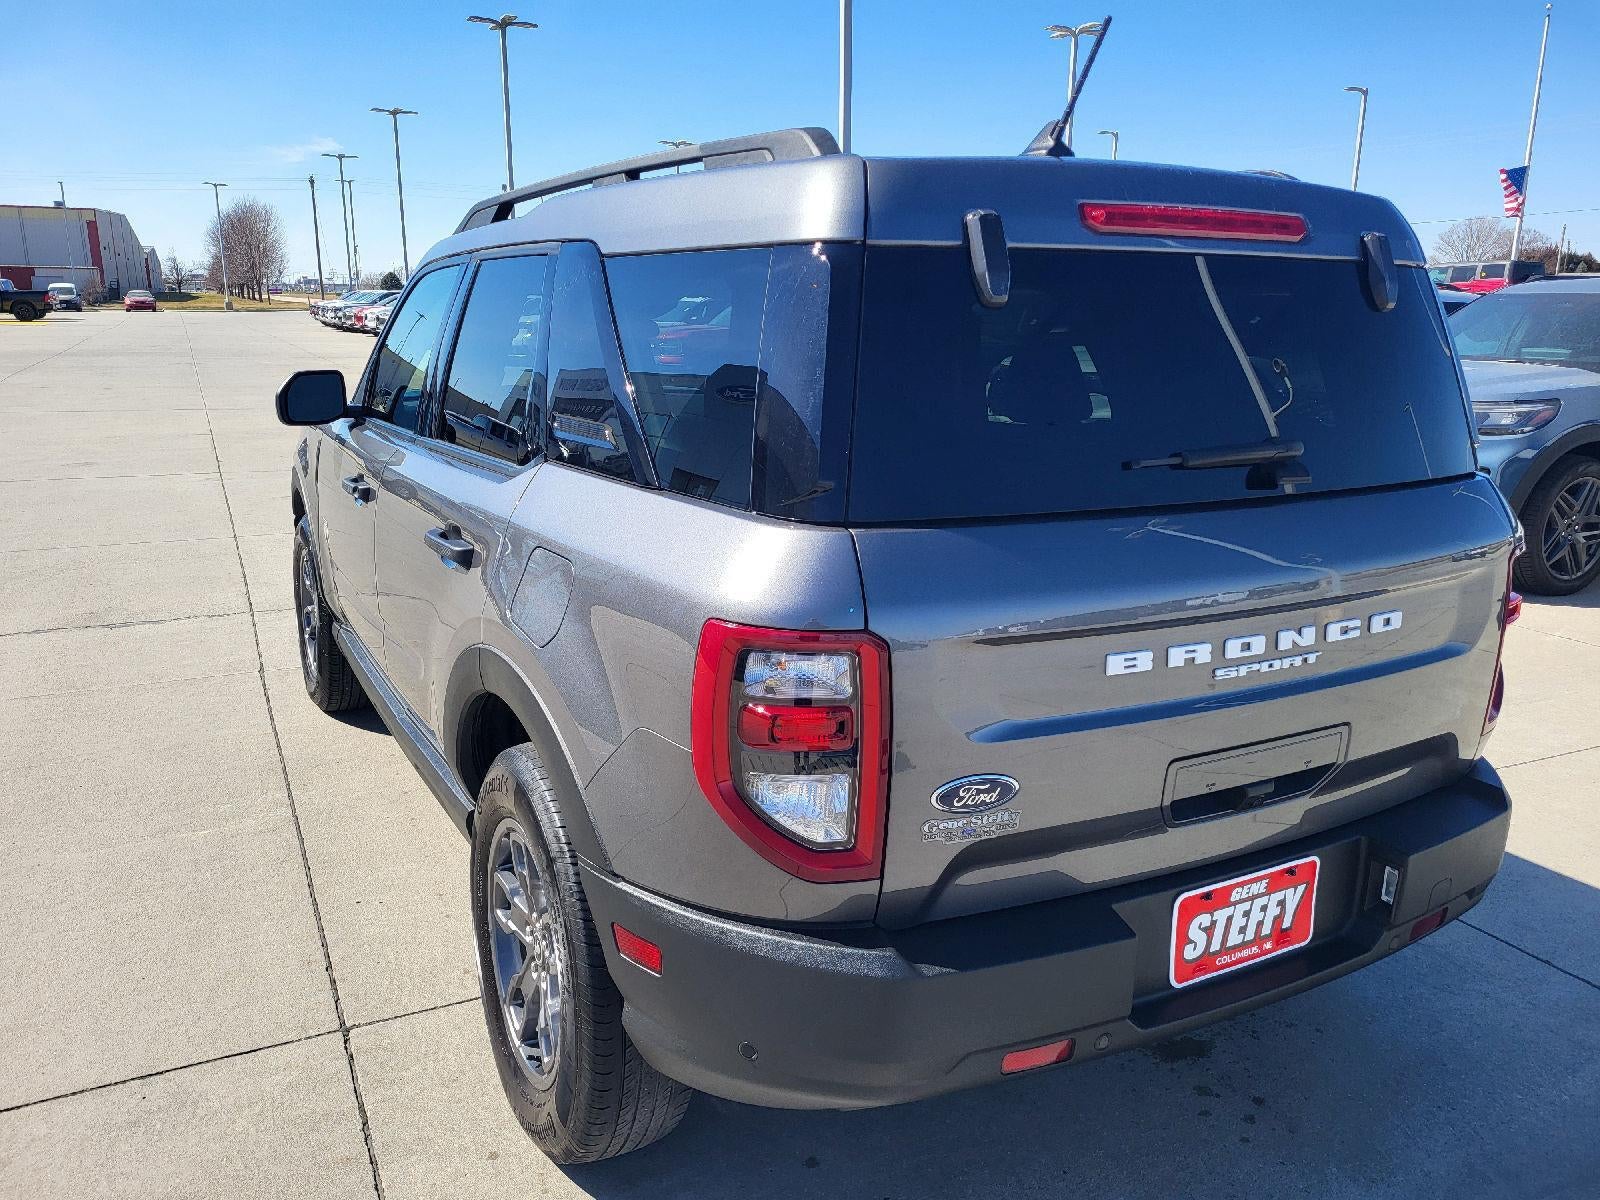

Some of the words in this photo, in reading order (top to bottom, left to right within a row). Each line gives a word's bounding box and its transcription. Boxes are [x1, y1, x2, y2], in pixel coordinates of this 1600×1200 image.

[1105, 608, 1402, 676] BRONCO
[1212, 651, 1322, 680] SPORT
[953, 783, 1002, 807] Ford
[1230, 878, 1270, 902] GENE
[1183, 882, 1309, 962] STEFFY
[1215, 945, 1262, 966] COLUMBUS,
[1262, 940, 1273, 951] NE
